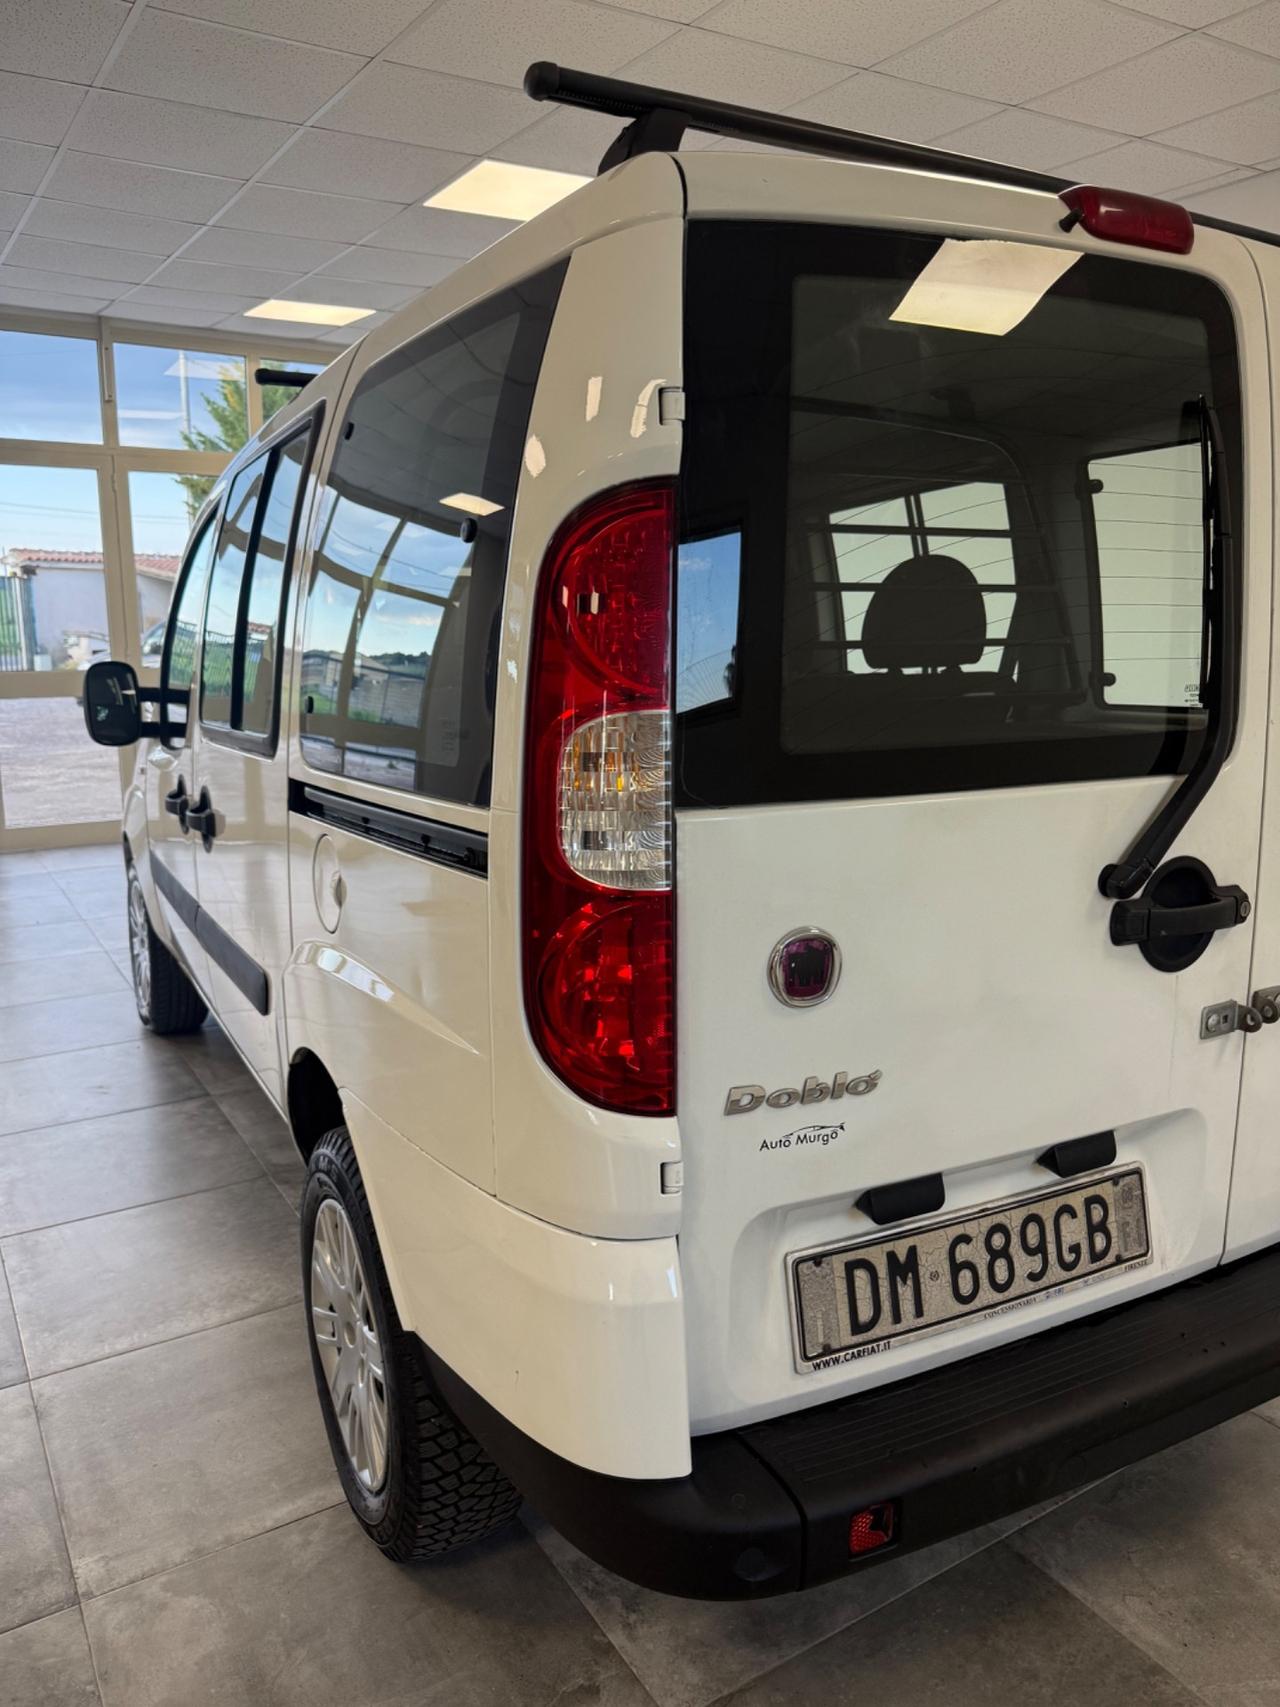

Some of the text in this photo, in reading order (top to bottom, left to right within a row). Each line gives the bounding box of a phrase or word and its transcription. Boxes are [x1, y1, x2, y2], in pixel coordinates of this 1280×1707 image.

[759, 1129, 839, 1152] Auto Murgo
[844, 1244, 924, 1337] DM
[812, 1340, 891, 1372] WWW.CARFIAT.IT
